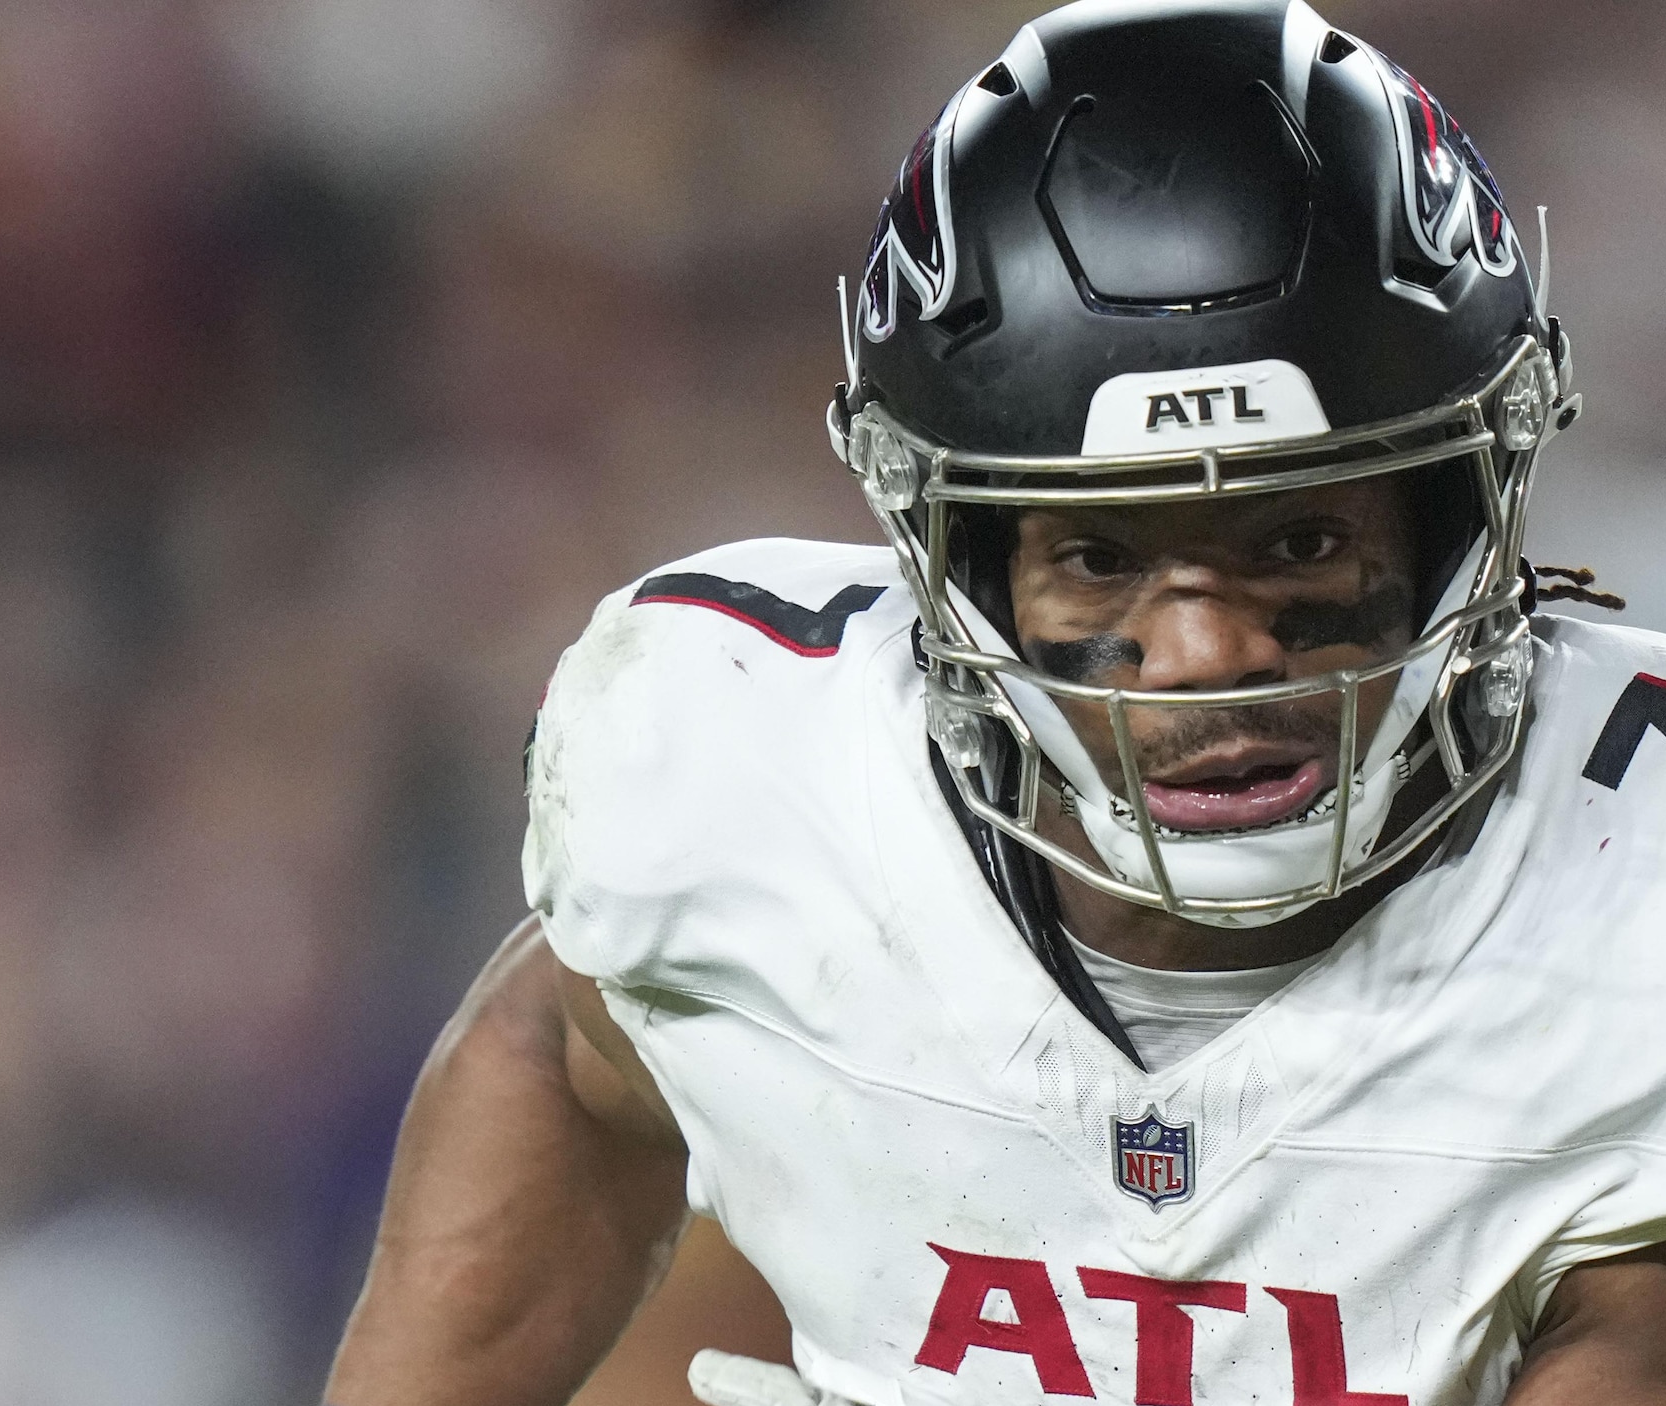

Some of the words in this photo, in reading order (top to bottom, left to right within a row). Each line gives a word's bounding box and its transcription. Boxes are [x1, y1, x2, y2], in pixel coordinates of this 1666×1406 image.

[1146, 386, 1263, 429] ATL
[629, 571, 890, 658] 7
[1124, 1150, 1182, 1194] NFL
